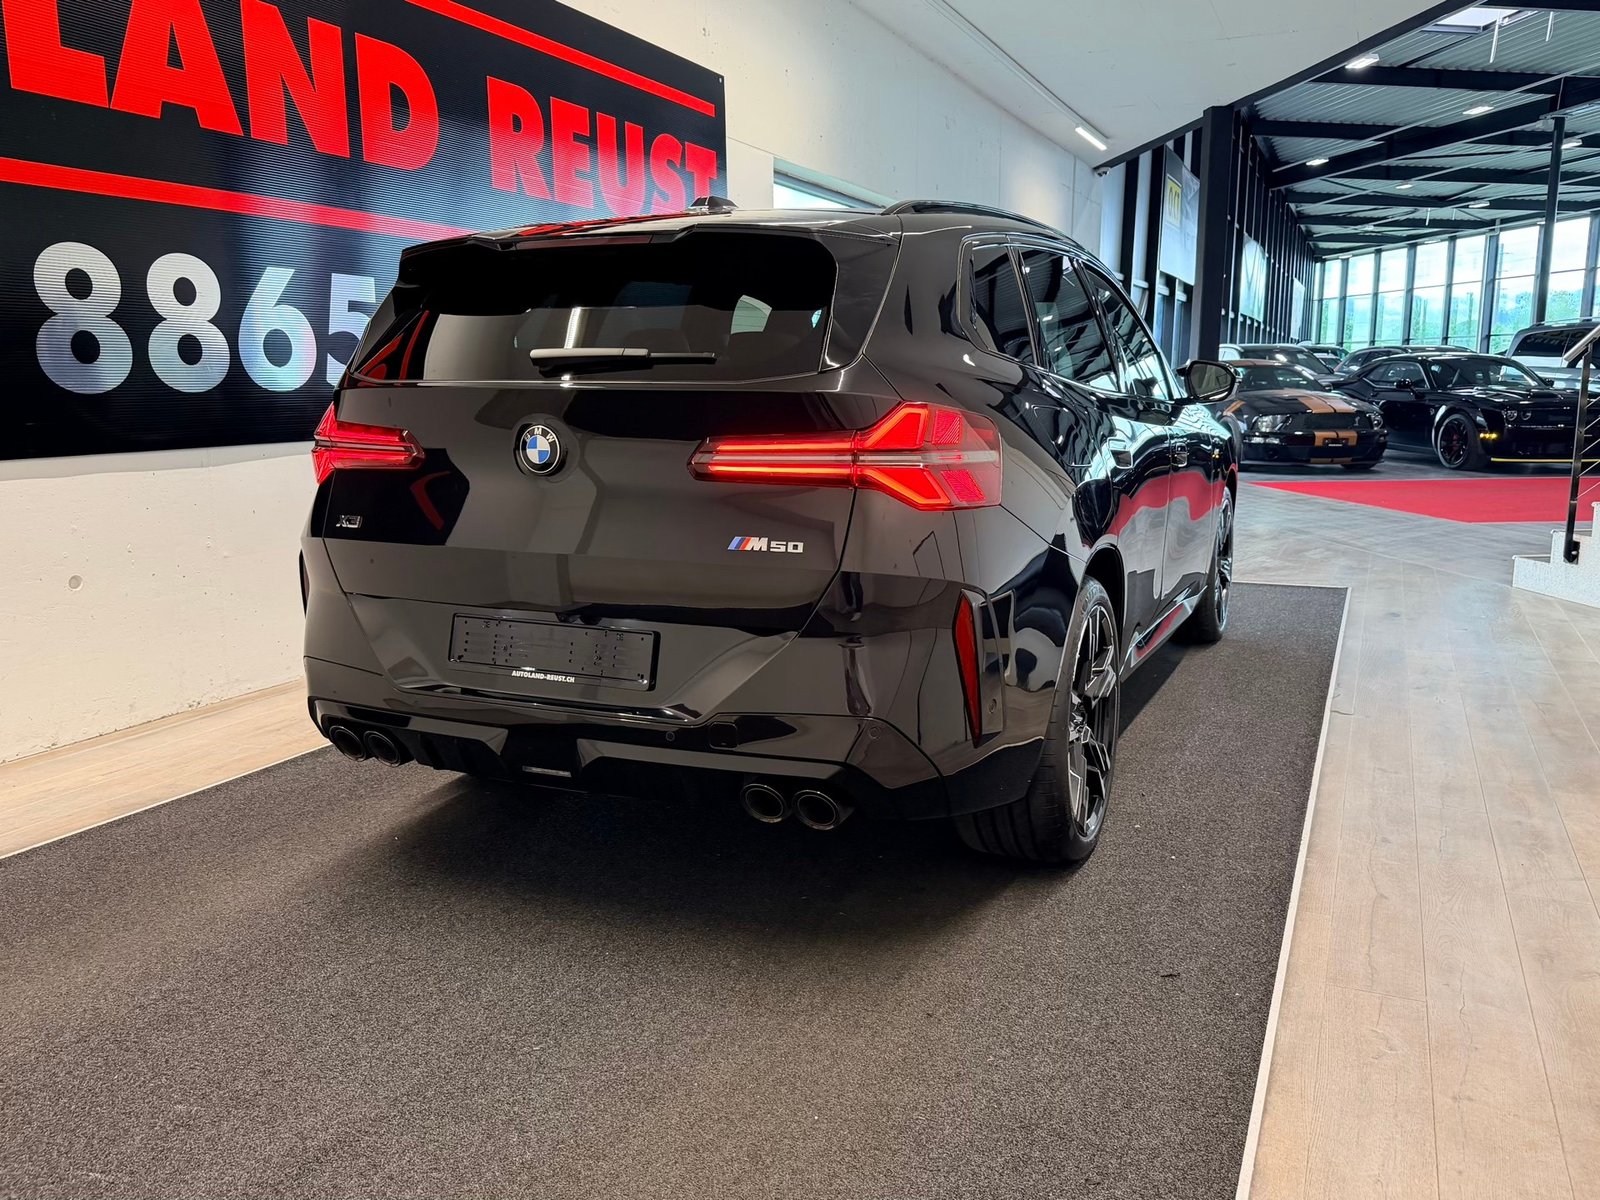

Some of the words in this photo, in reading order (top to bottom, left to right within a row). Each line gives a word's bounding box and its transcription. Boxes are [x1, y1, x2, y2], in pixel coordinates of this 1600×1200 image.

[487, 76, 717, 217] REUST
[524, 427, 555, 443] BMW
[511, 670, 575, 683] AUTOLAND-REUST.CH
